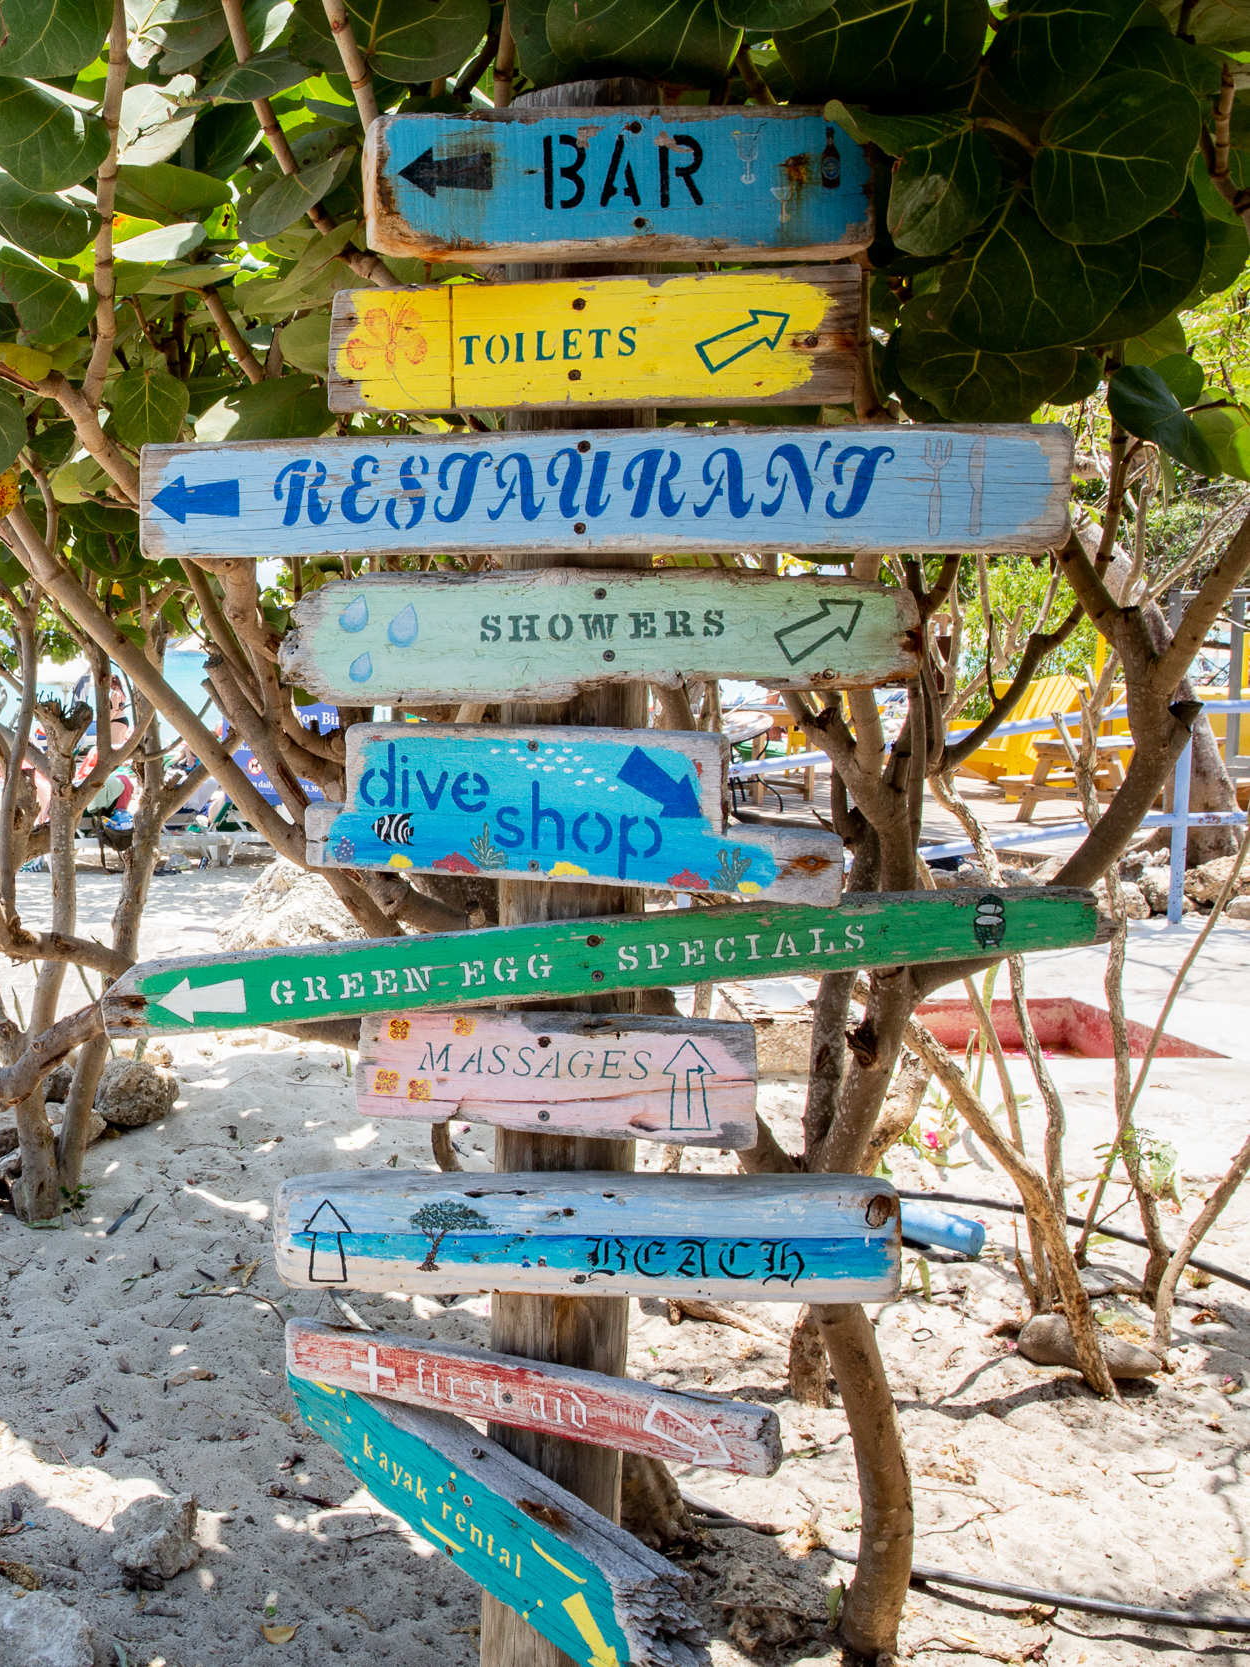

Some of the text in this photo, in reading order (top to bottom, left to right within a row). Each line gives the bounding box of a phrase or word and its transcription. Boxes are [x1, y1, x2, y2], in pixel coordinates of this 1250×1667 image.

[543, 134, 704, 210] BAR
[459, 326, 637, 366] TOILETS
[273, 440, 896, 531] RESTAURANT
[480, 609, 725, 643] SHOWERS
[360, 742, 490, 813] dive
[494, 780, 663, 880] shop
[270, 924, 865, 1006] GREEN EGG SPECIALS
[417, 1042, 652, 1080] MASSAGES
[585, 1237, 806, 1288] BEACH
[415, 1358, 588, 1429] first aid
[363, 1433, 521, 1579] kayak rental
